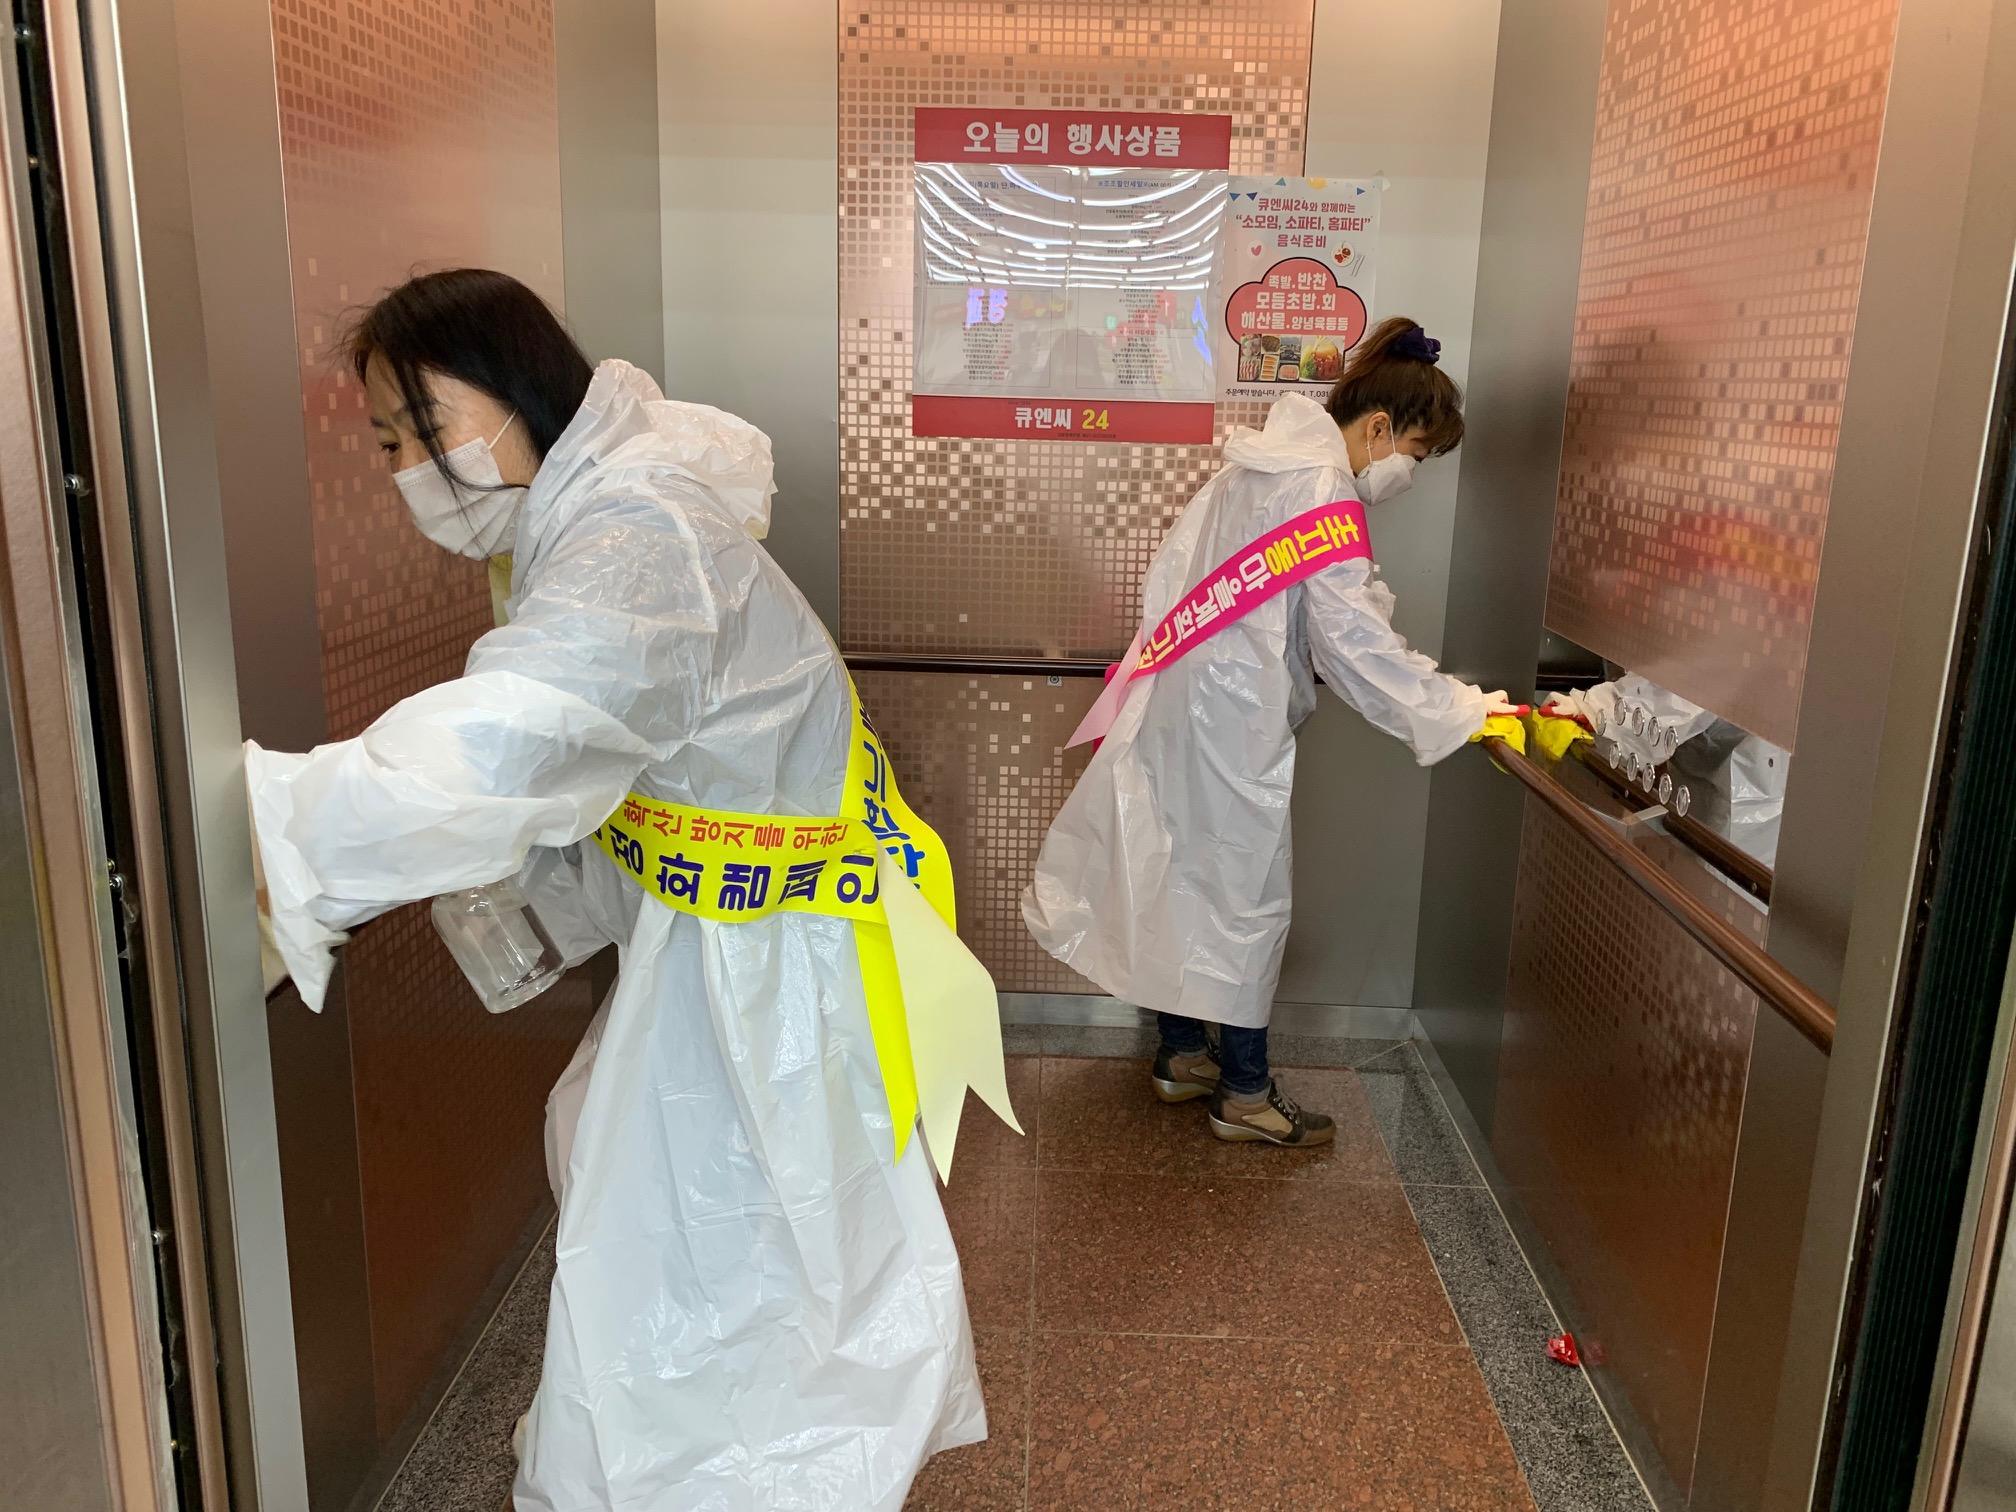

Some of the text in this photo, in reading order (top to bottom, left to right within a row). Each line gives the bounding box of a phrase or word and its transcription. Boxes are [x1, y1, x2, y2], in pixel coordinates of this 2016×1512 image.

[963, 122, 1181, 157] 오늘의 행사상품
[1258, 198, 1356, 214] 큐엔씨24와 함께하는
[1285, 216, 1325, 232] 소파티,
[1328, 217, 1371, 232] 홈파티”
[1277, 234, 1327, 249] 음식준비
[1225, 388, 1250, 397] 주문예약
[1014, 407, 1110, 430] 큐엔씨 24
[623, 799, 850, 852] 확산 방지를 위한
